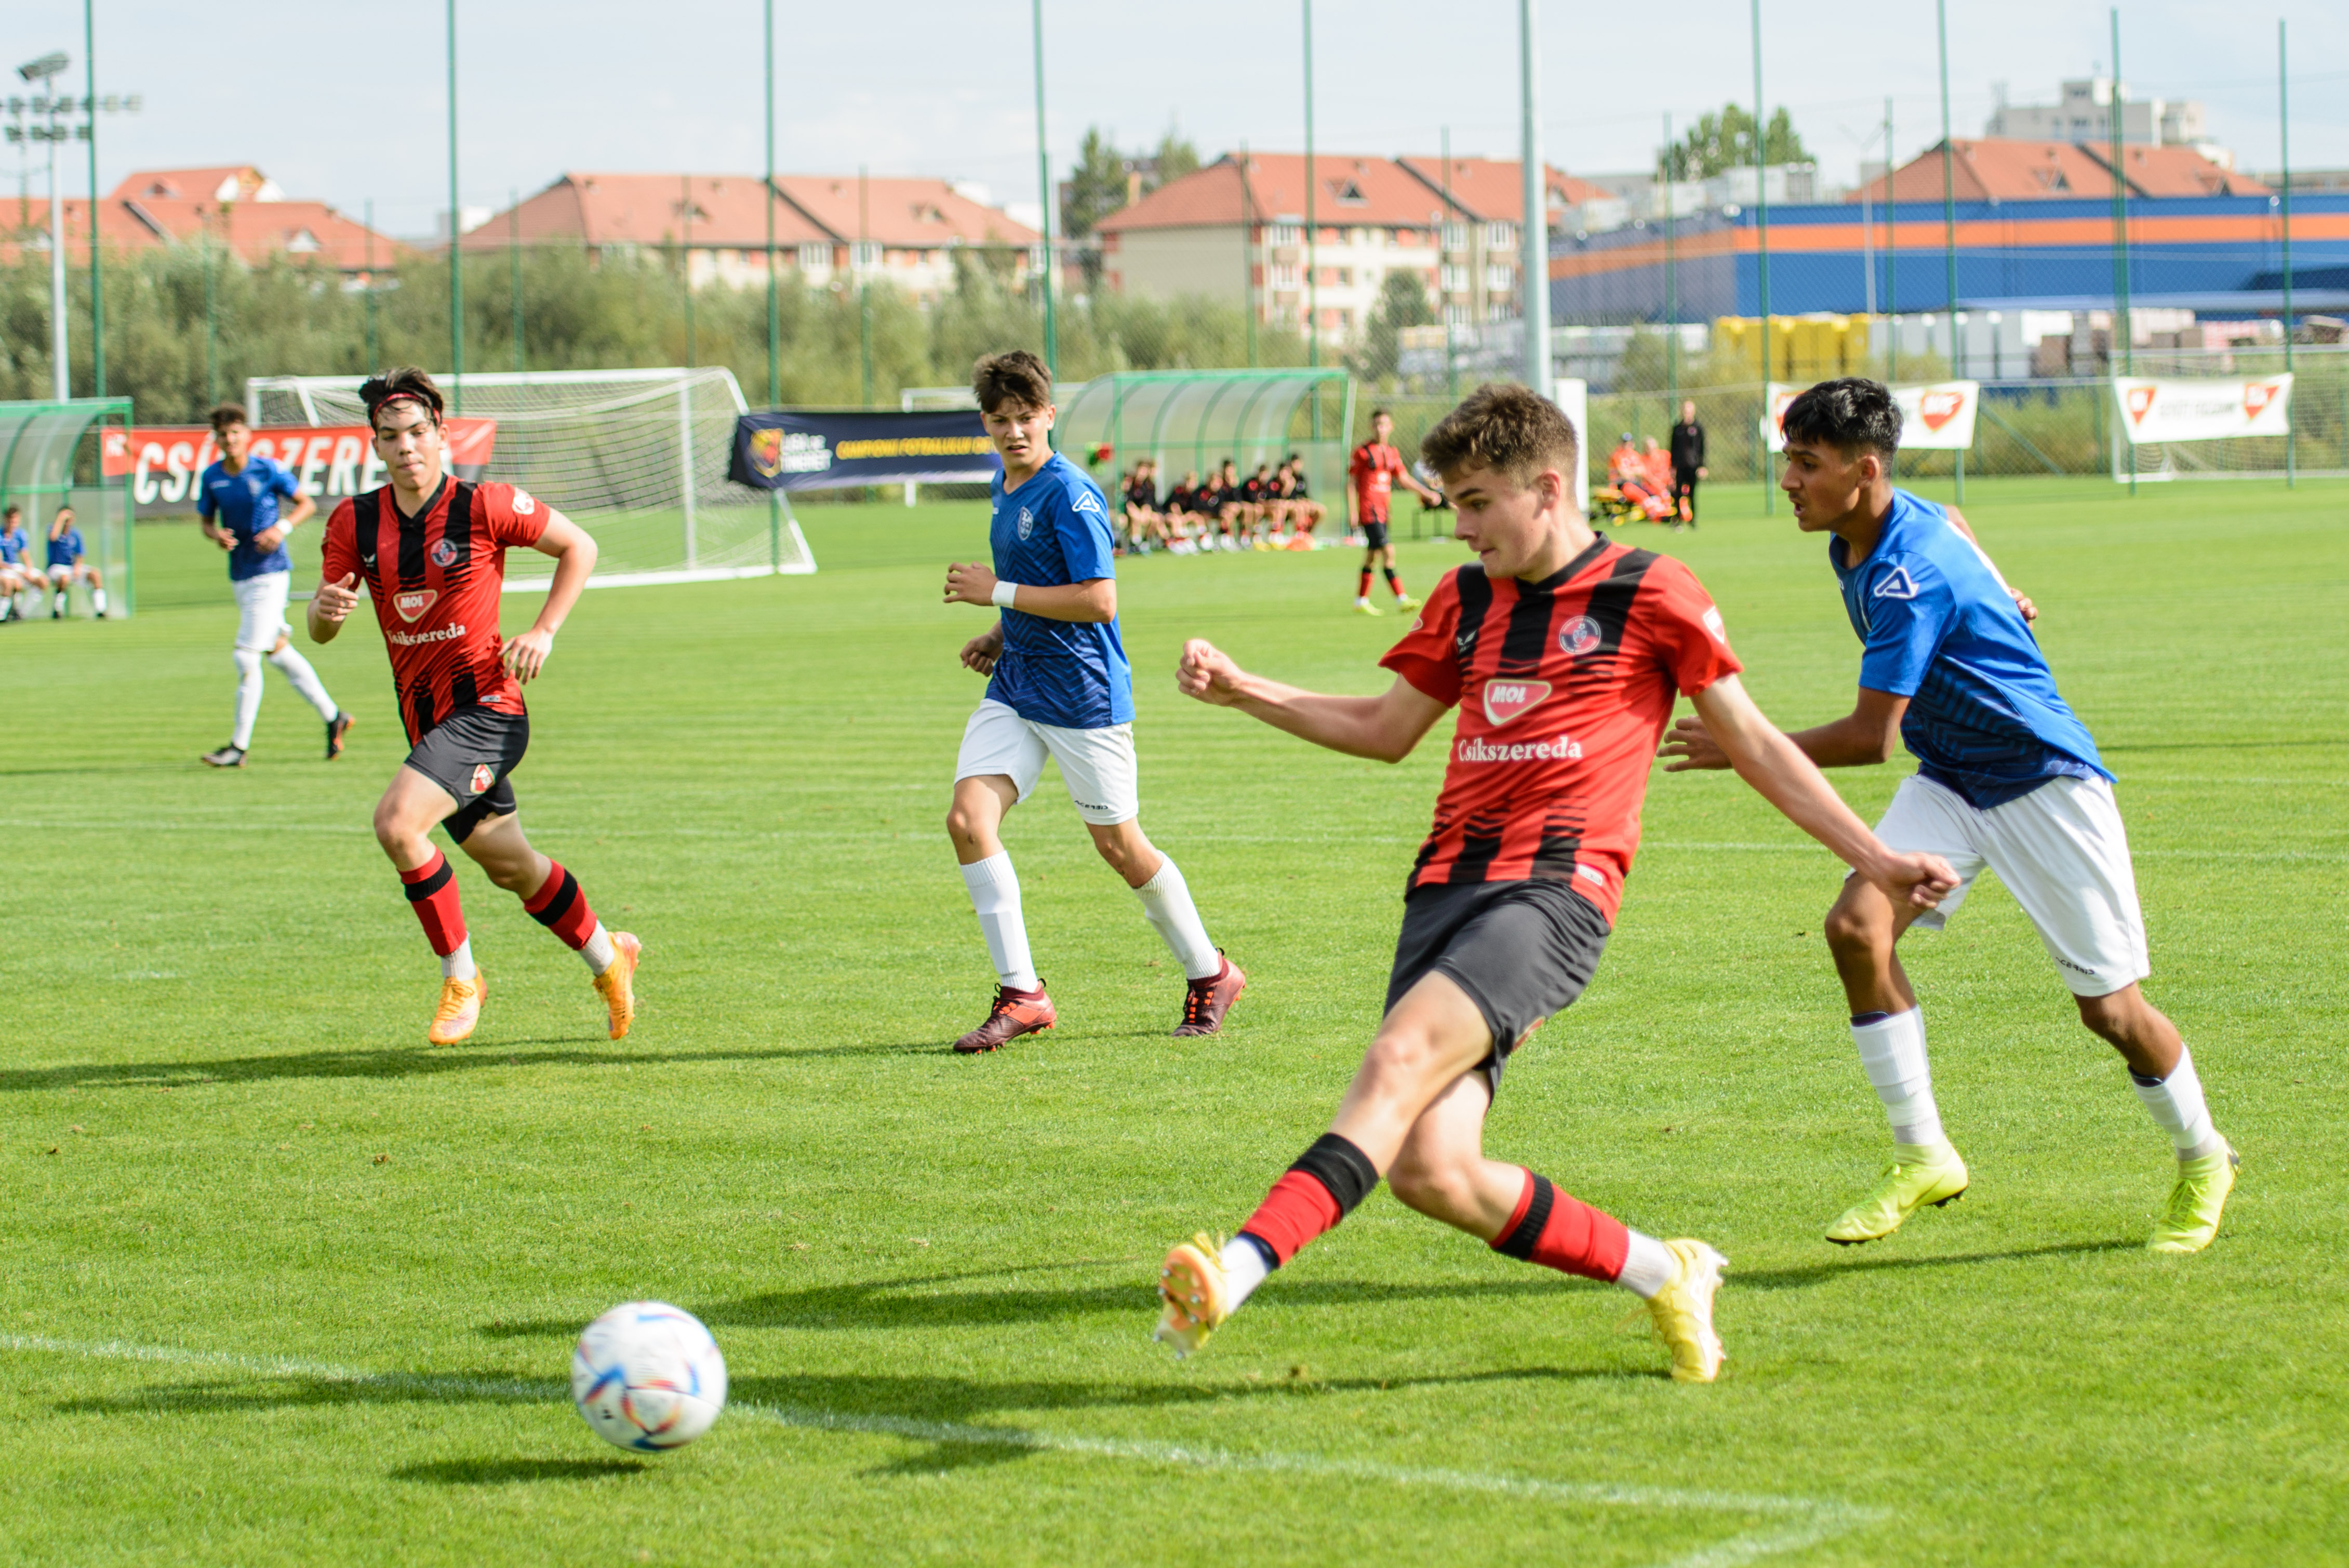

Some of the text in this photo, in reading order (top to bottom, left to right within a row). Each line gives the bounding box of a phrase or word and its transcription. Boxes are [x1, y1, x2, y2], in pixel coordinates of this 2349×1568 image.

[401, 595, 423, 609] MOL
[1491, 686, 1526, 703] MOL
[1459, 736, 1582, 761] Csíkszereda
